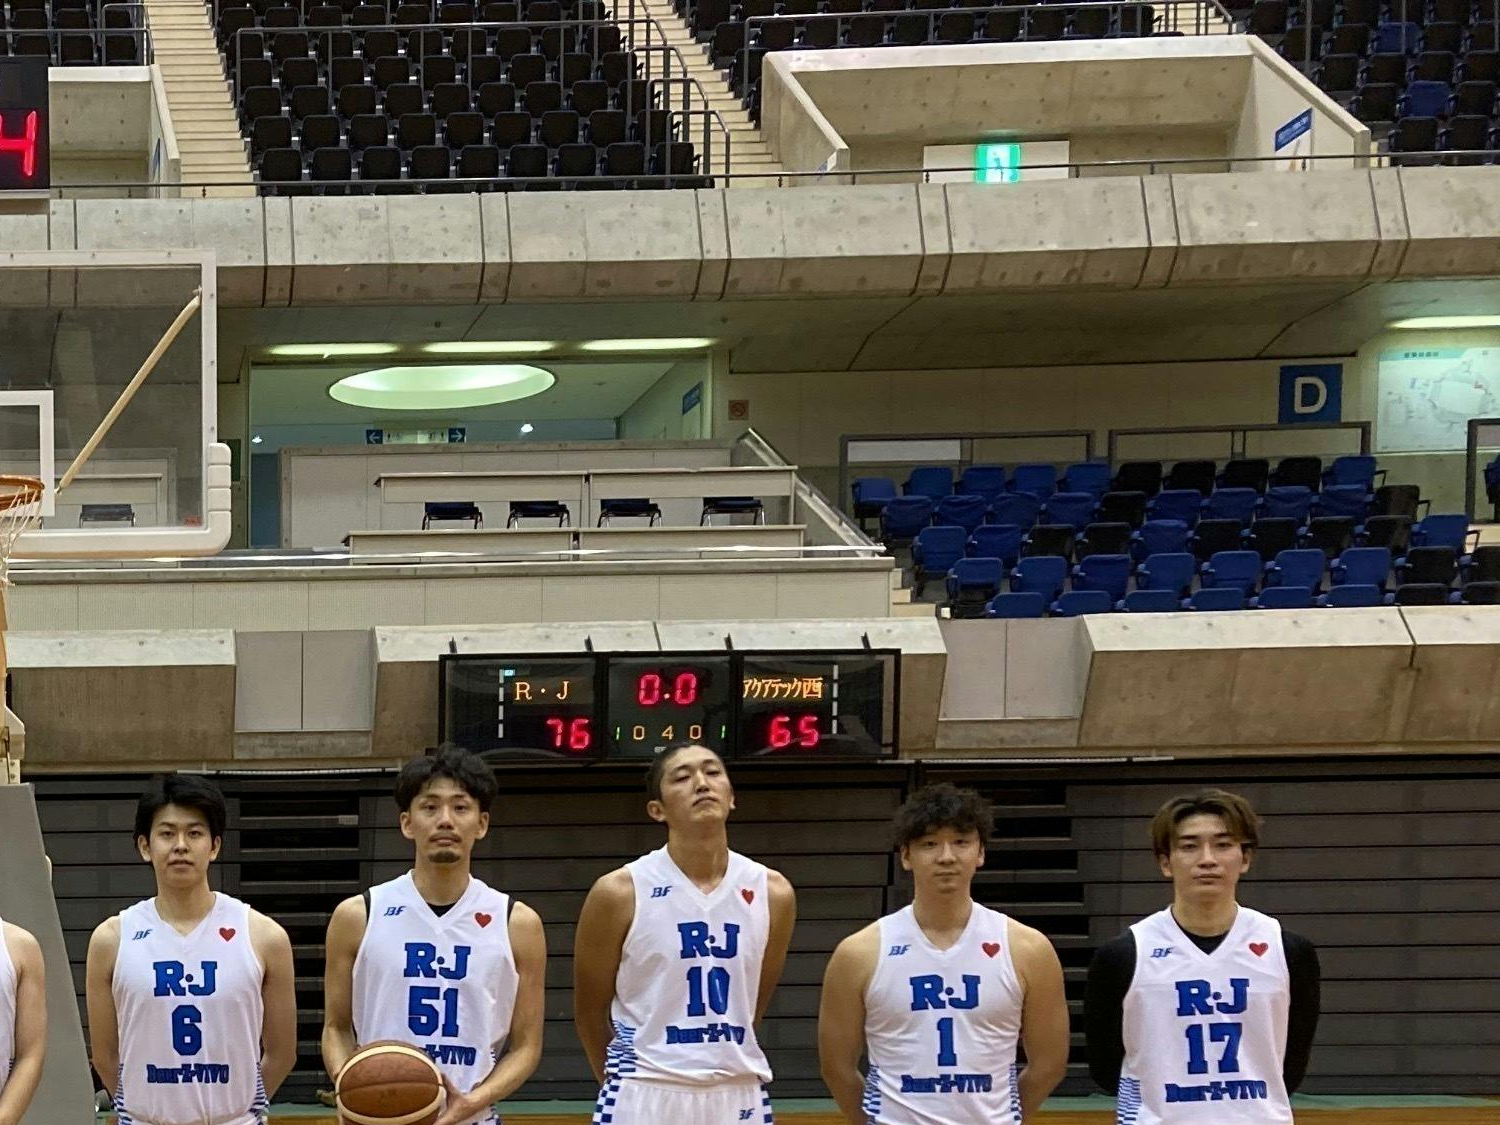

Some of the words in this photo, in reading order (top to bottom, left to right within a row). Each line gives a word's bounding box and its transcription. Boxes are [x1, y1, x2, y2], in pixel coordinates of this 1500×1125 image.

[1294, 376, 1327, 414] D
[638, 673, 697, 705] 0.0
[546, 718, 590, 749] 76
[661, 725, 674, 740] 4
[770, 716, 819, 747] 65
[408, 986, 459, 1037] 51
[687, 966, 730, 1017] 10
[172, 1005, 202, 1056] 6
[937, 1018, 957, 1066] 1
[1185, 1023, 1242, 1074] 17
